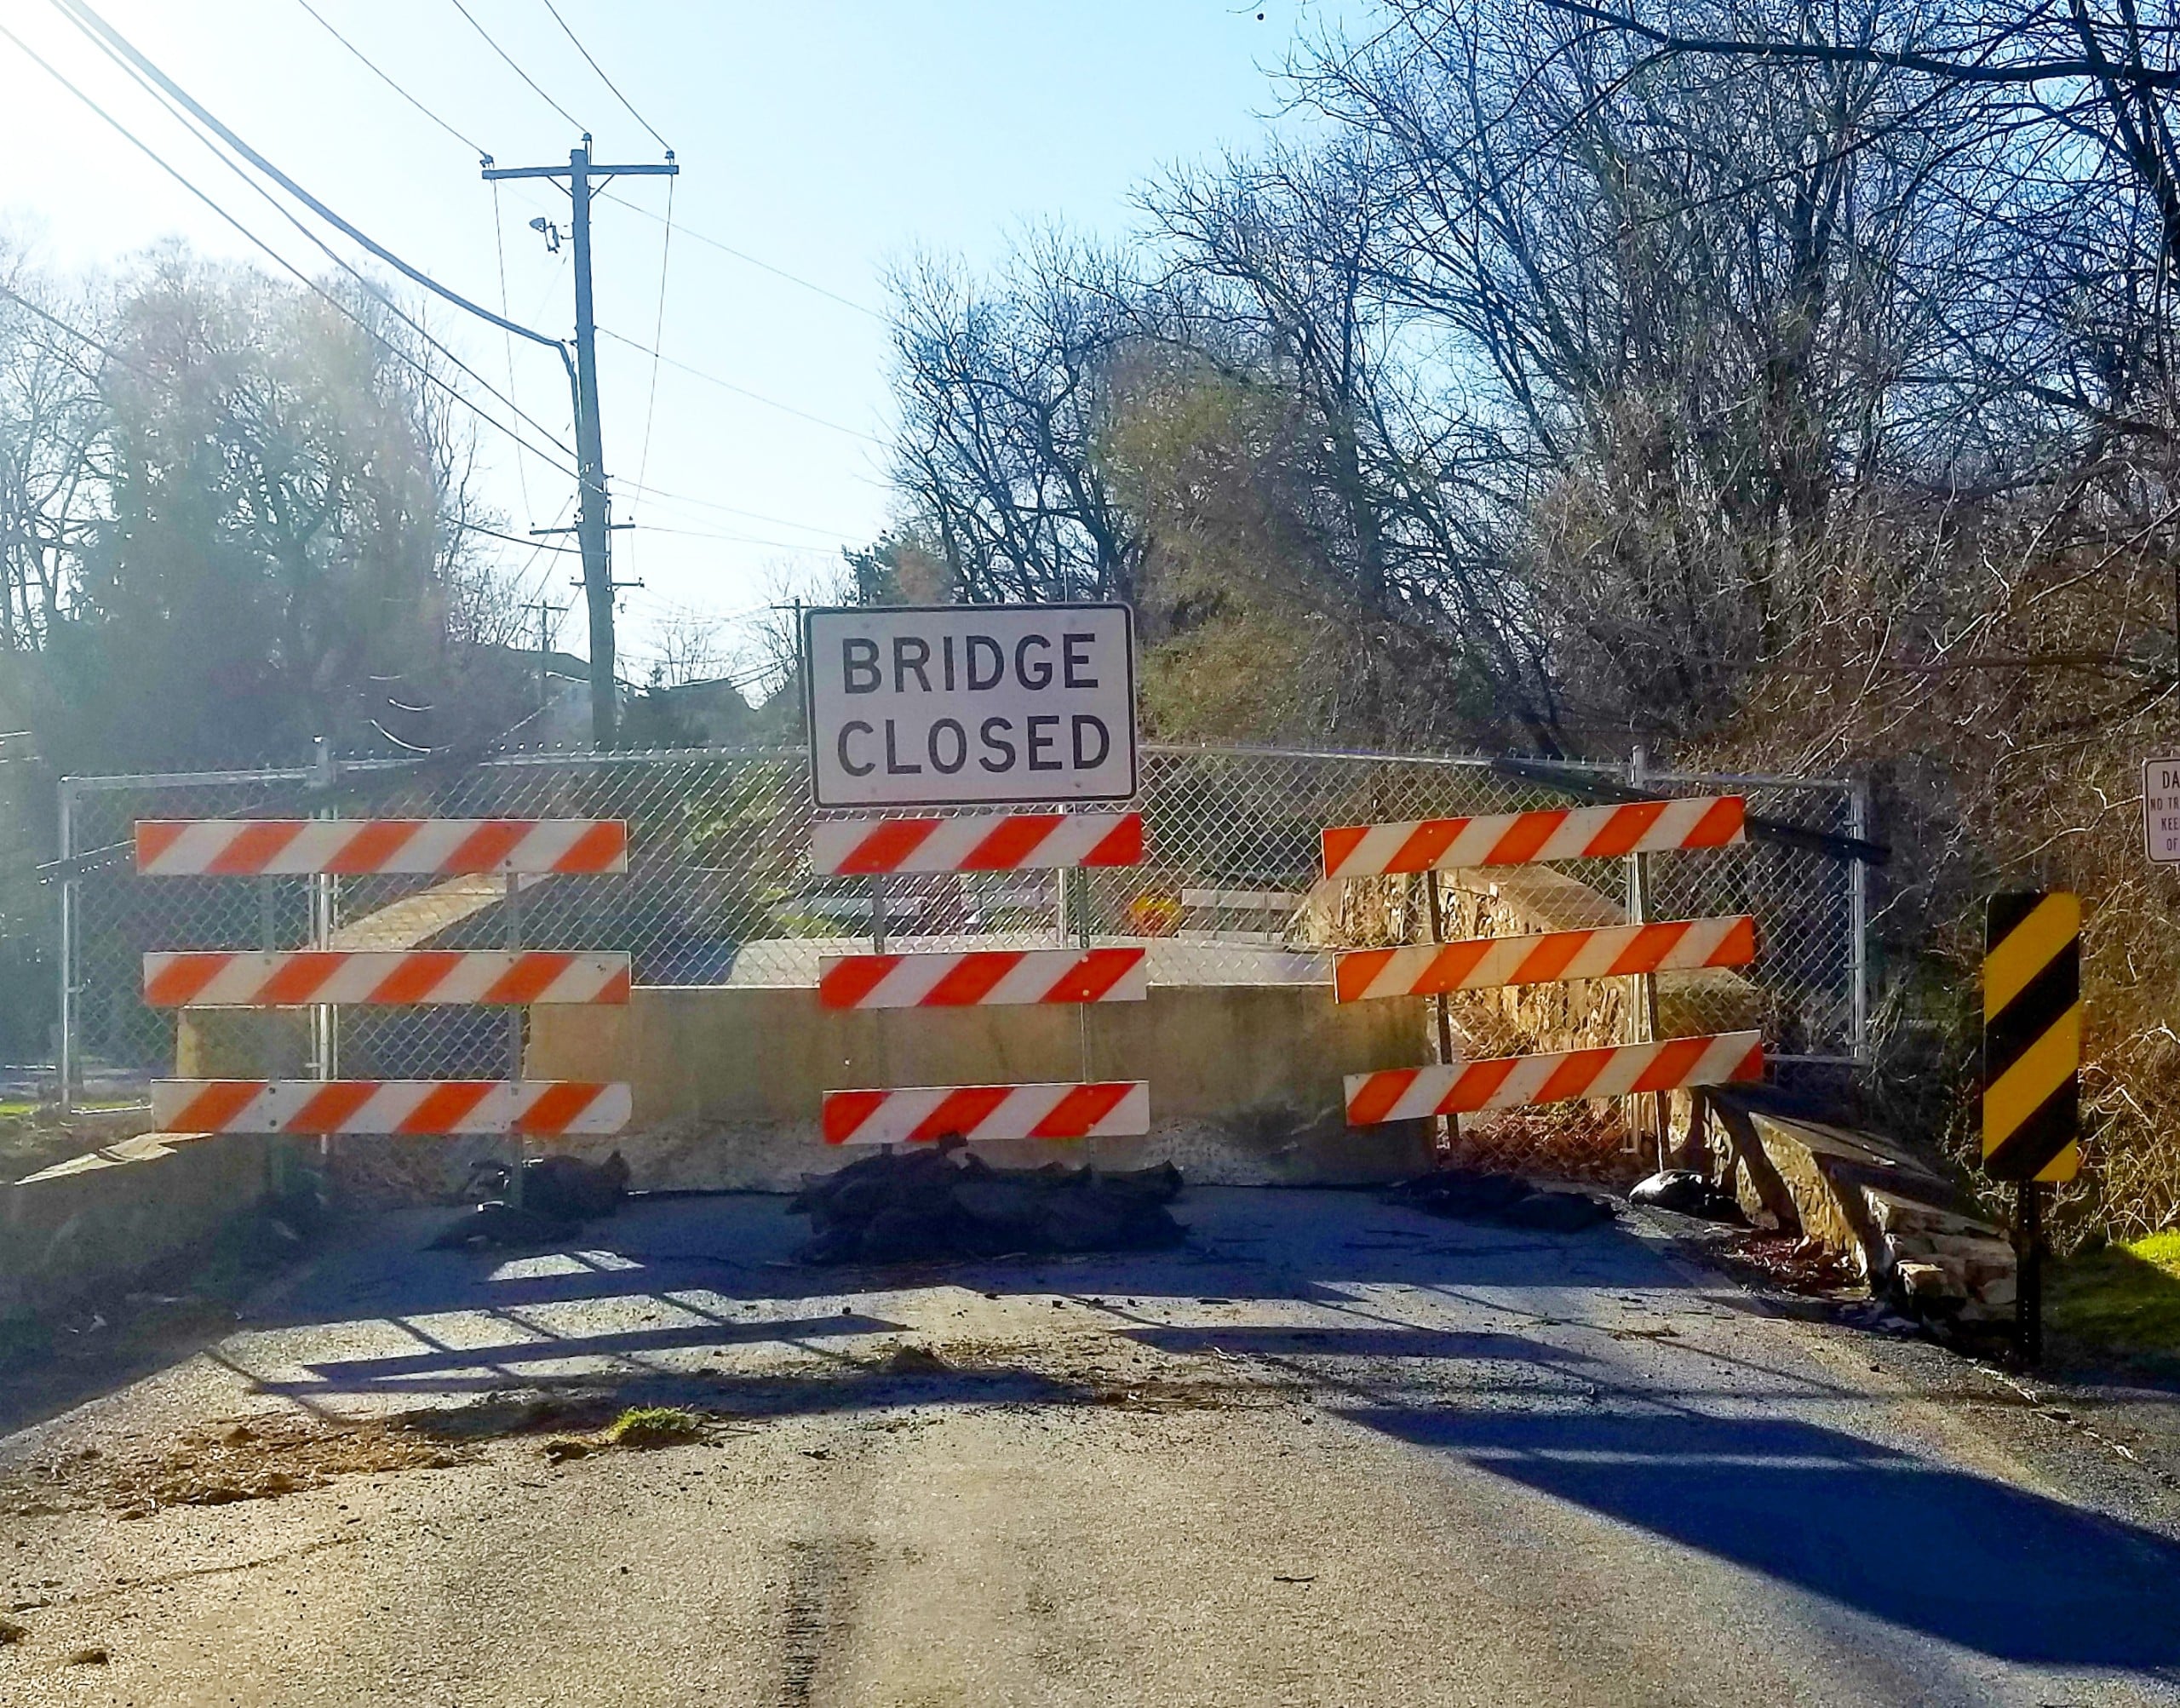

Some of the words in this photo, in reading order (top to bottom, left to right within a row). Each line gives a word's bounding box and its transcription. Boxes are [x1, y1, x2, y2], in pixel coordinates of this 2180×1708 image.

[842, 633, 1099, 694] BRIDGE
[837, 714, 1110, 777] CLOSED
[2162, 770, 2180, 788] DA
[2150, 798, 2163, 811] NO
